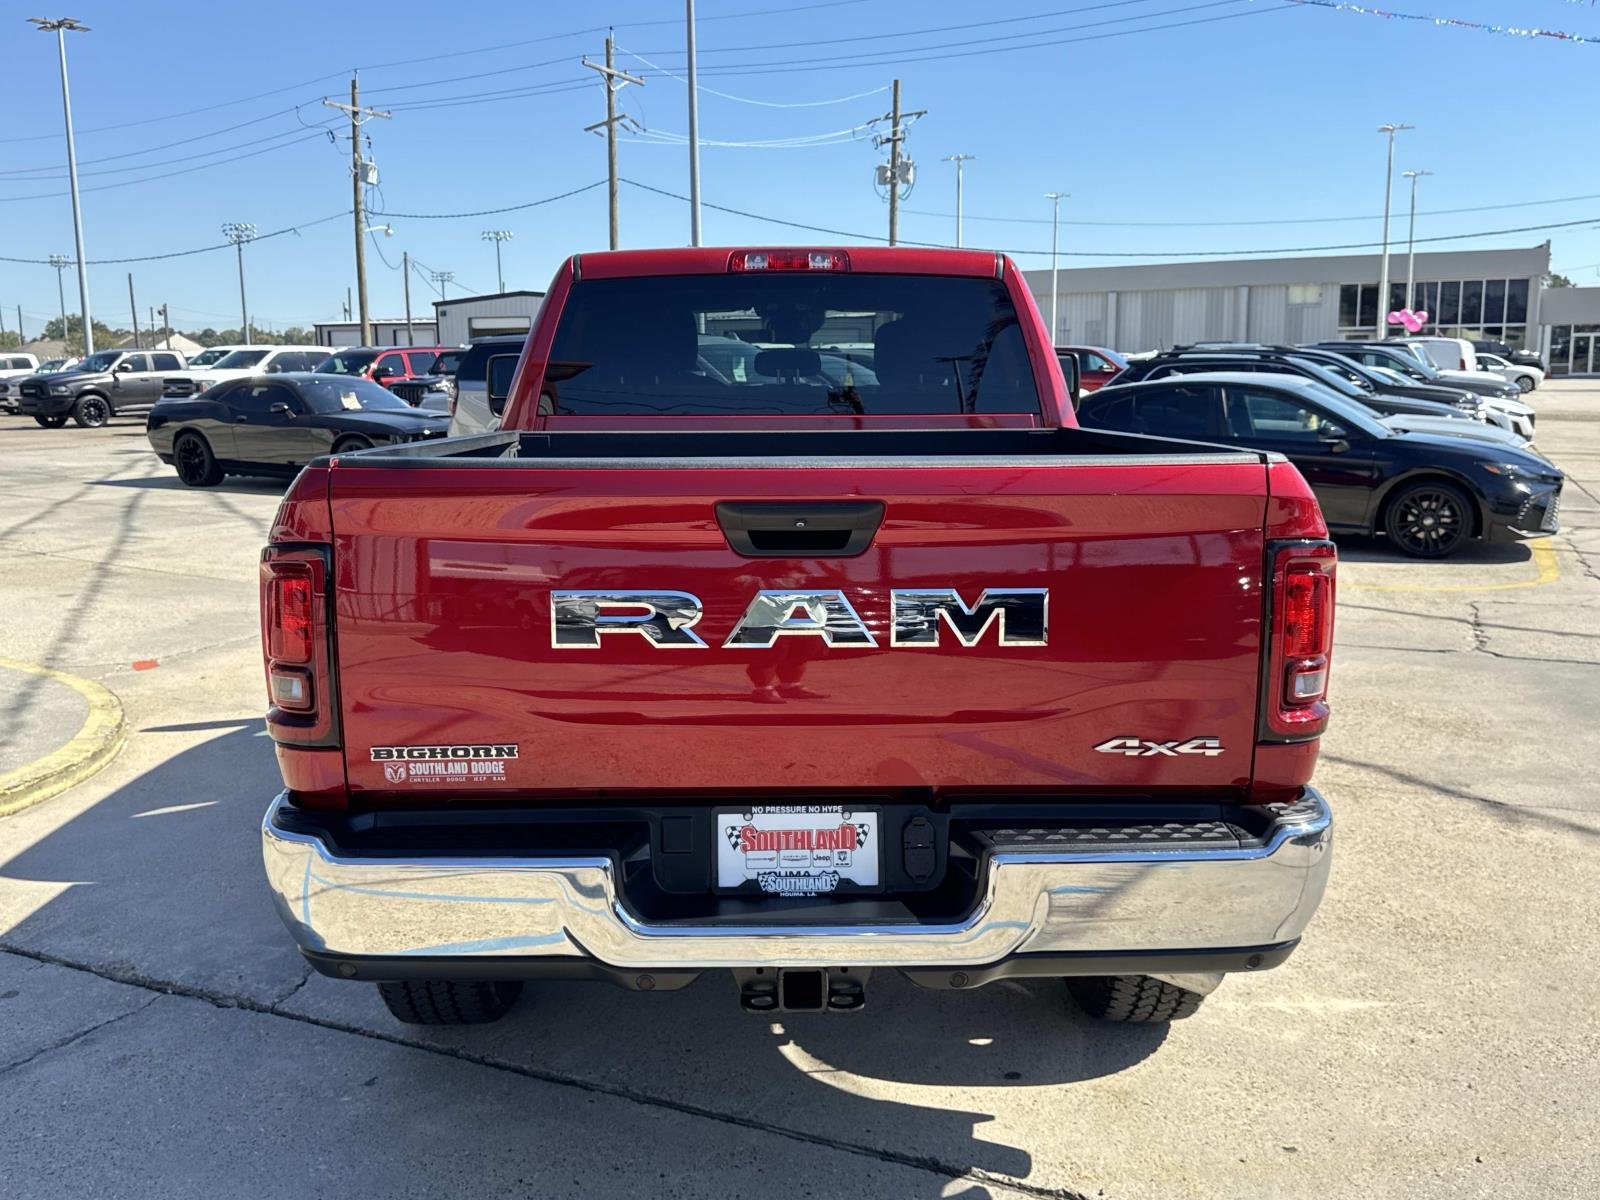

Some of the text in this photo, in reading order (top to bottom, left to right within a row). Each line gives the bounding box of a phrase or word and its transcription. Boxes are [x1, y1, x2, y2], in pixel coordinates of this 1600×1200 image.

[550, 588, 1049, 649] RAM
[370, 745, 519, 761] BIGHORN
[1092, 737, 1225, 757] 4x4
[409, 761, 505, 775] SOUTHLAND DODGE
[751, 806, 764, 814] NO
[766, 806, 807, 814] PRESSURE
[767, 876, 831, 891] SOUTHLAND
